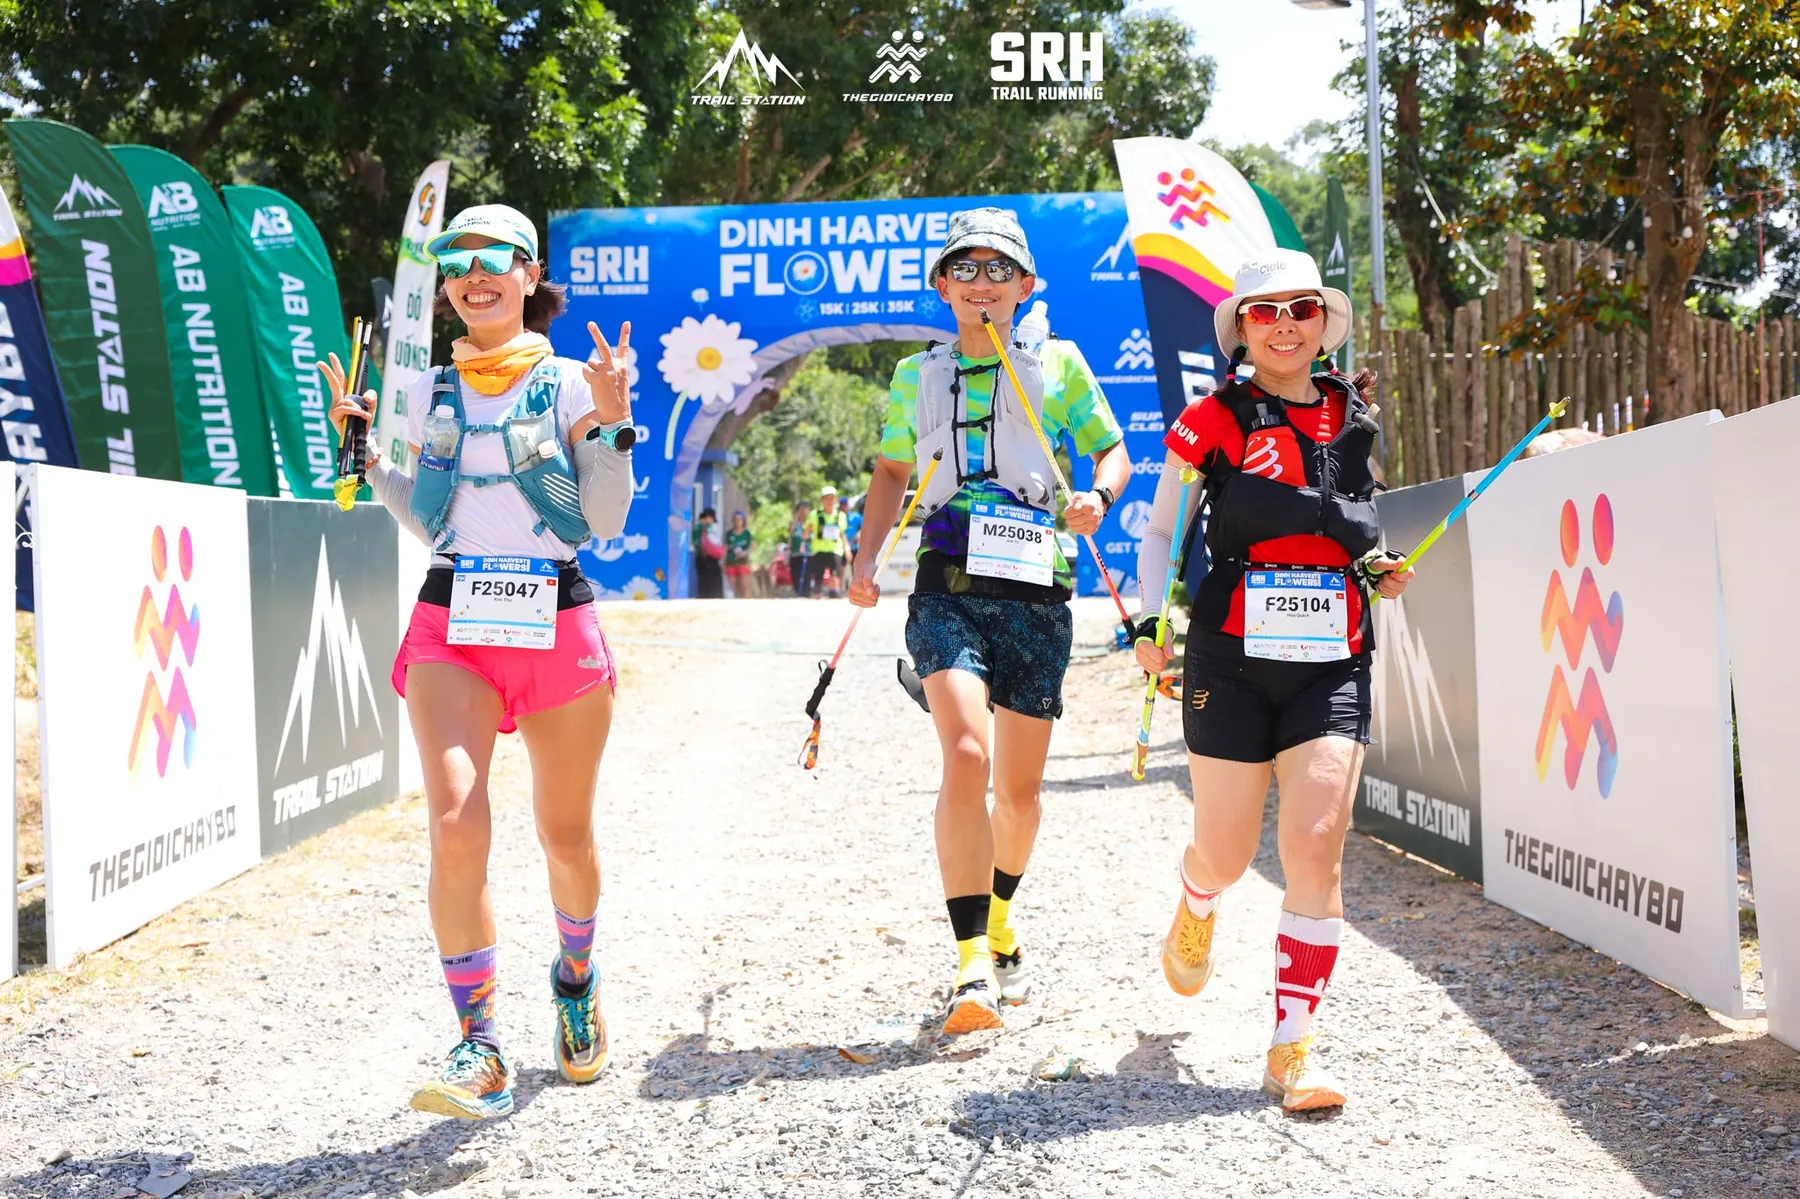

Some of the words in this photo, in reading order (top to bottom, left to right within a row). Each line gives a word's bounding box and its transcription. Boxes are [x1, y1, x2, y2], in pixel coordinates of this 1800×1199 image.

[150, 212, 201, 226] NUTRITION
[719, 217, 812, 248] DINH
[169, 243, 207, 293] AB
[570, 246, 650, 283] SRH
[278, 271, 310, 317] AB
[572, 285, 600, 297] TRAIL
[603, 283, 649, 296] RUNNING
[820, 302, 843, 315] 15K
[852, 301, 878, 314] 25K
[886, 300, 914, 314] 35K
[82, 239, 130, 415] STATION
[182, 303, 243, 487] NUTRITION
[287, 324, 335, 489] NUTRITION
[1170, 419, 1200, 447] RUN
[983, 523, 1042, 544] M25038
[1105, 541, 1132, 554] GET
[482, 562, 527, 572] FLOWERS
[471, 580, 539, 598] F25047
[1265, 597, 1331, 612] F25104
[273, 775, 321, 825] TRAIL
[324, 750, 384, 804] STATION
[1363, 775, 1403, 820] TRAIL
[1405, 790, 1471, 846] STATION
